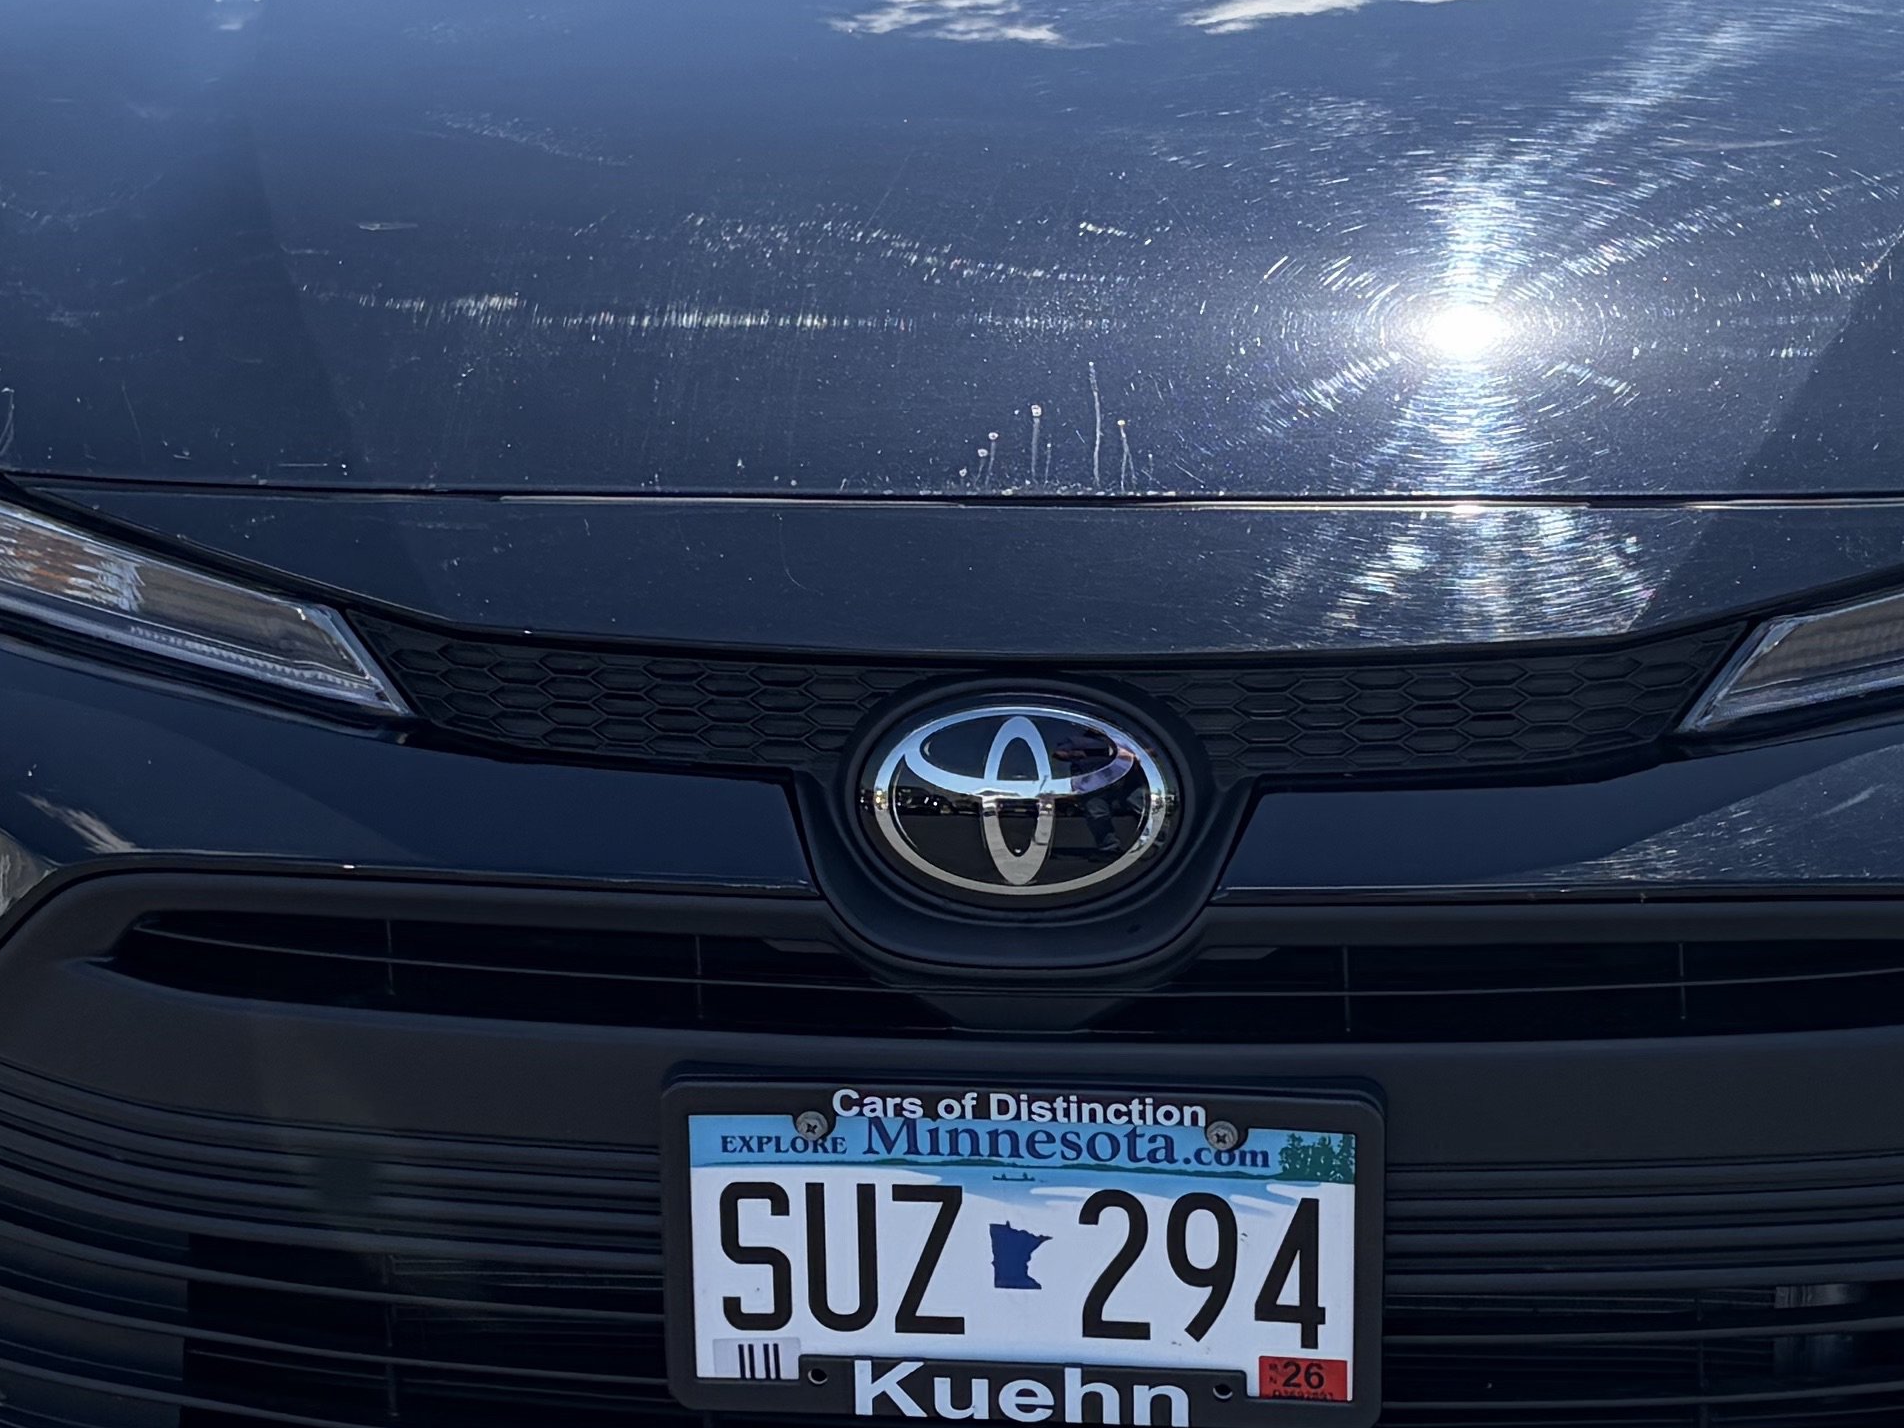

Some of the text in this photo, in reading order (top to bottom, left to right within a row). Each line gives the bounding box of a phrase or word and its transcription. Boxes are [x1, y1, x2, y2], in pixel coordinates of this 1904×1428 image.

[832, 1088, 1207, 1127] Cars of Distinction
[720, 1135, 848, 1154] EXPLORE
[719, 1181, 1326, 1349] SUZ 294
[852, 1359, 1190, 1428] Kuehn
[1282, 1361, 1325, 1389] 26
